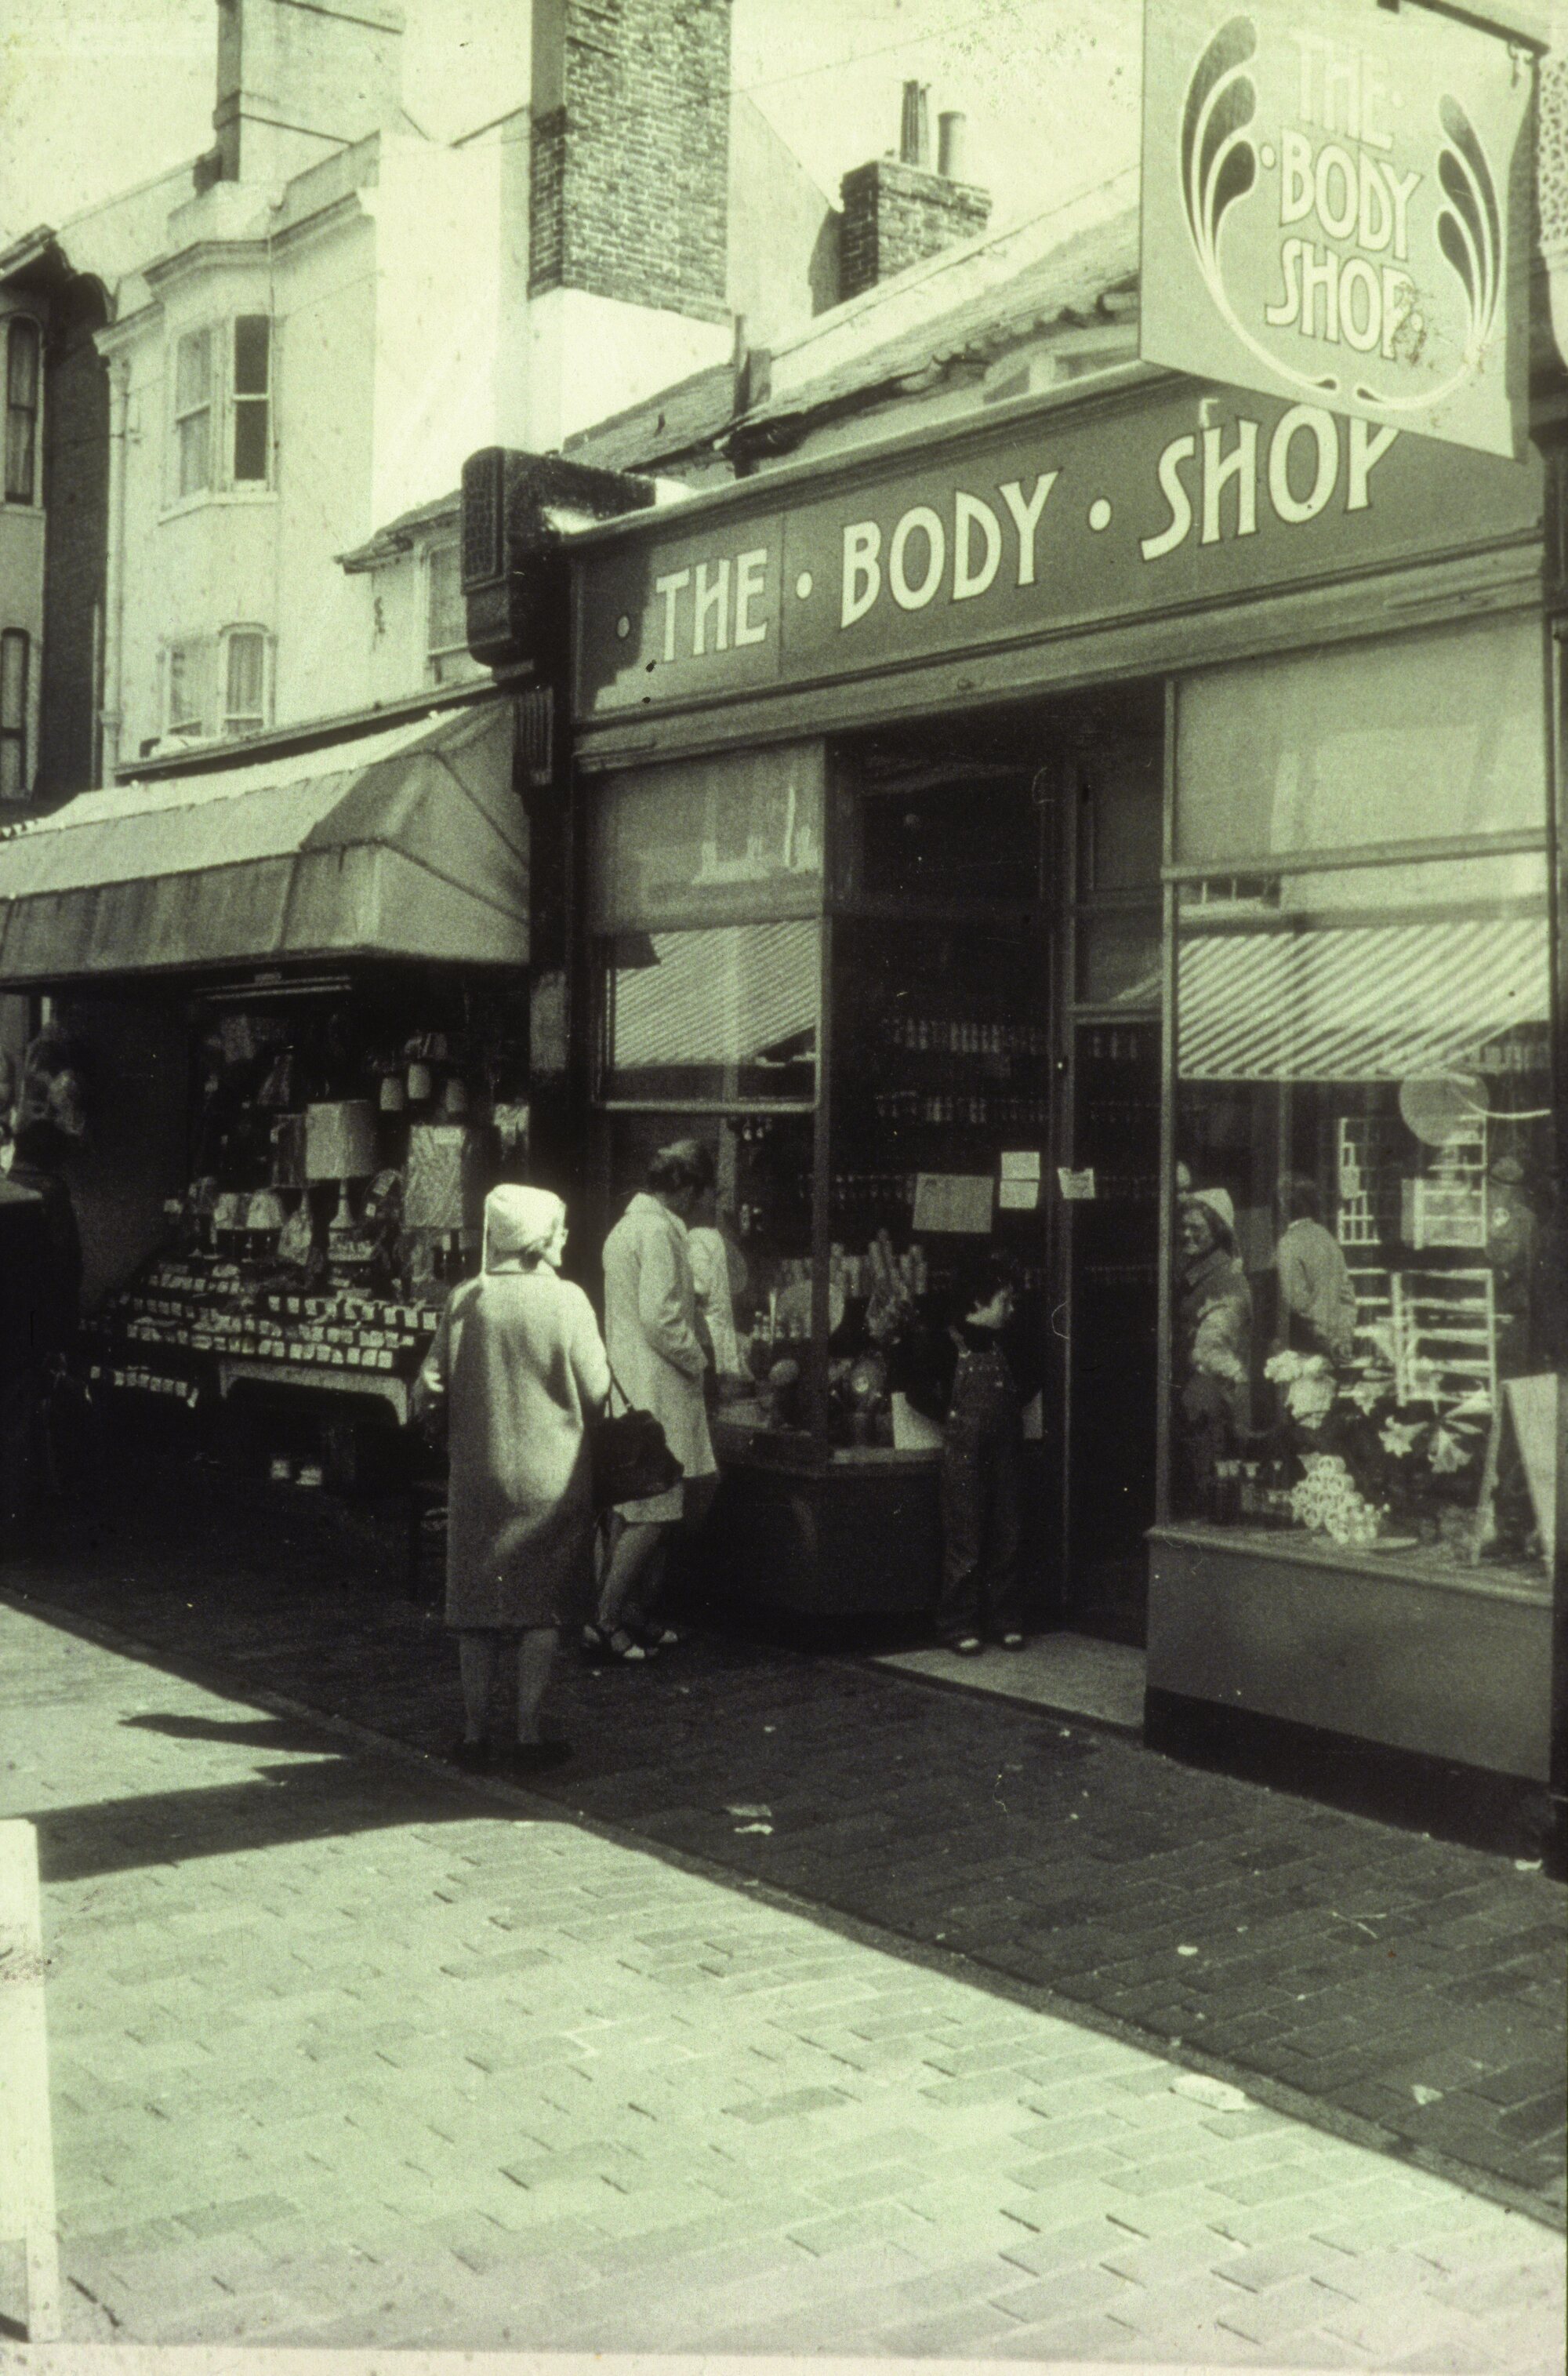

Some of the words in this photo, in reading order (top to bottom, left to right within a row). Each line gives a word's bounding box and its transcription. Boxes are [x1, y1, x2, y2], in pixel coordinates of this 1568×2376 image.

[1290, 28, 1393, 151] THE
[1280, 127, 1423, 262] BODY
[1265, 238, 1414, 360] SHOP
[656, 549, 768, 663] THE
[840, 470, 1059, 629] BODY
